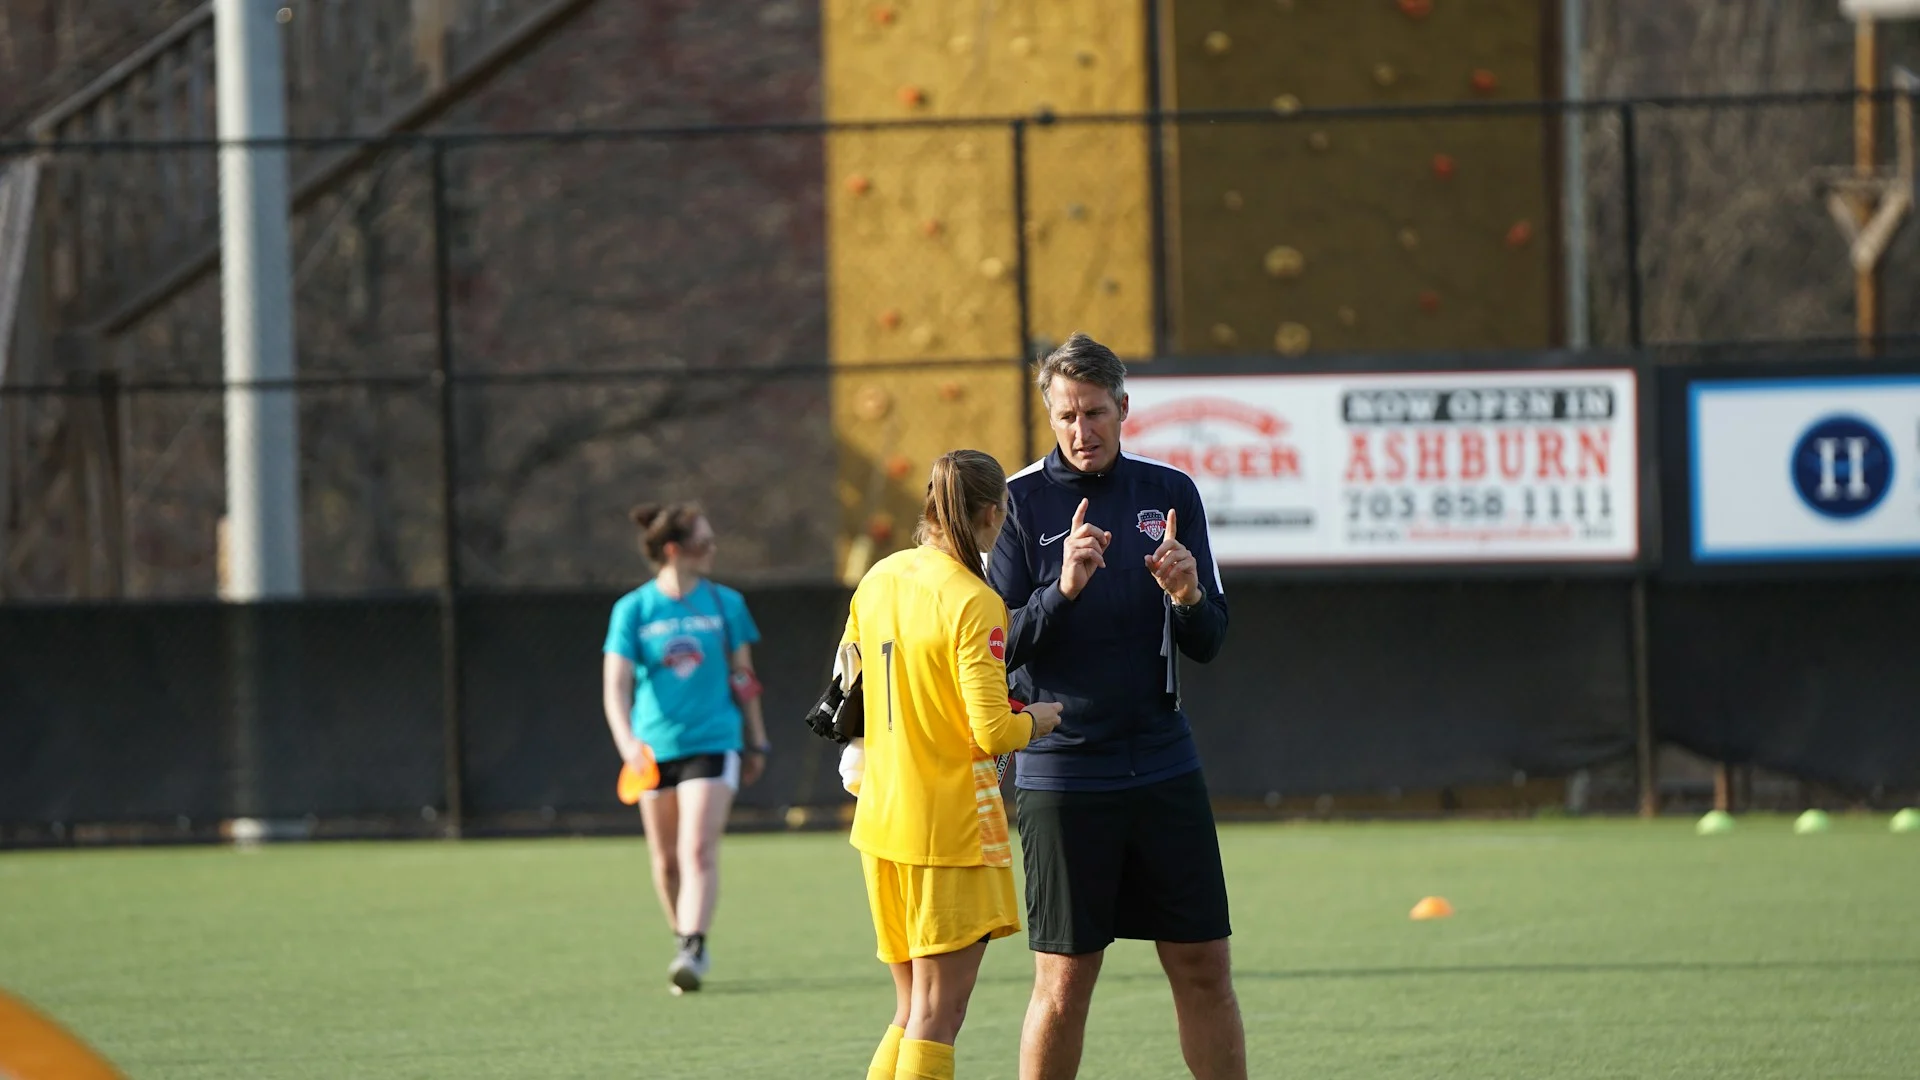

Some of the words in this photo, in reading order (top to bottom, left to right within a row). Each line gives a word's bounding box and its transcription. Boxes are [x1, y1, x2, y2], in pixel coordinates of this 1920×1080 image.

[1349, 391, 1436, 421] NOW
[1449, 390, 1554, 420] OPEN
[1565, 389, 1611, 418] IN
[1345, 427, 1610, 481] ASHBURN
[882, 640, 895, 732] 1
